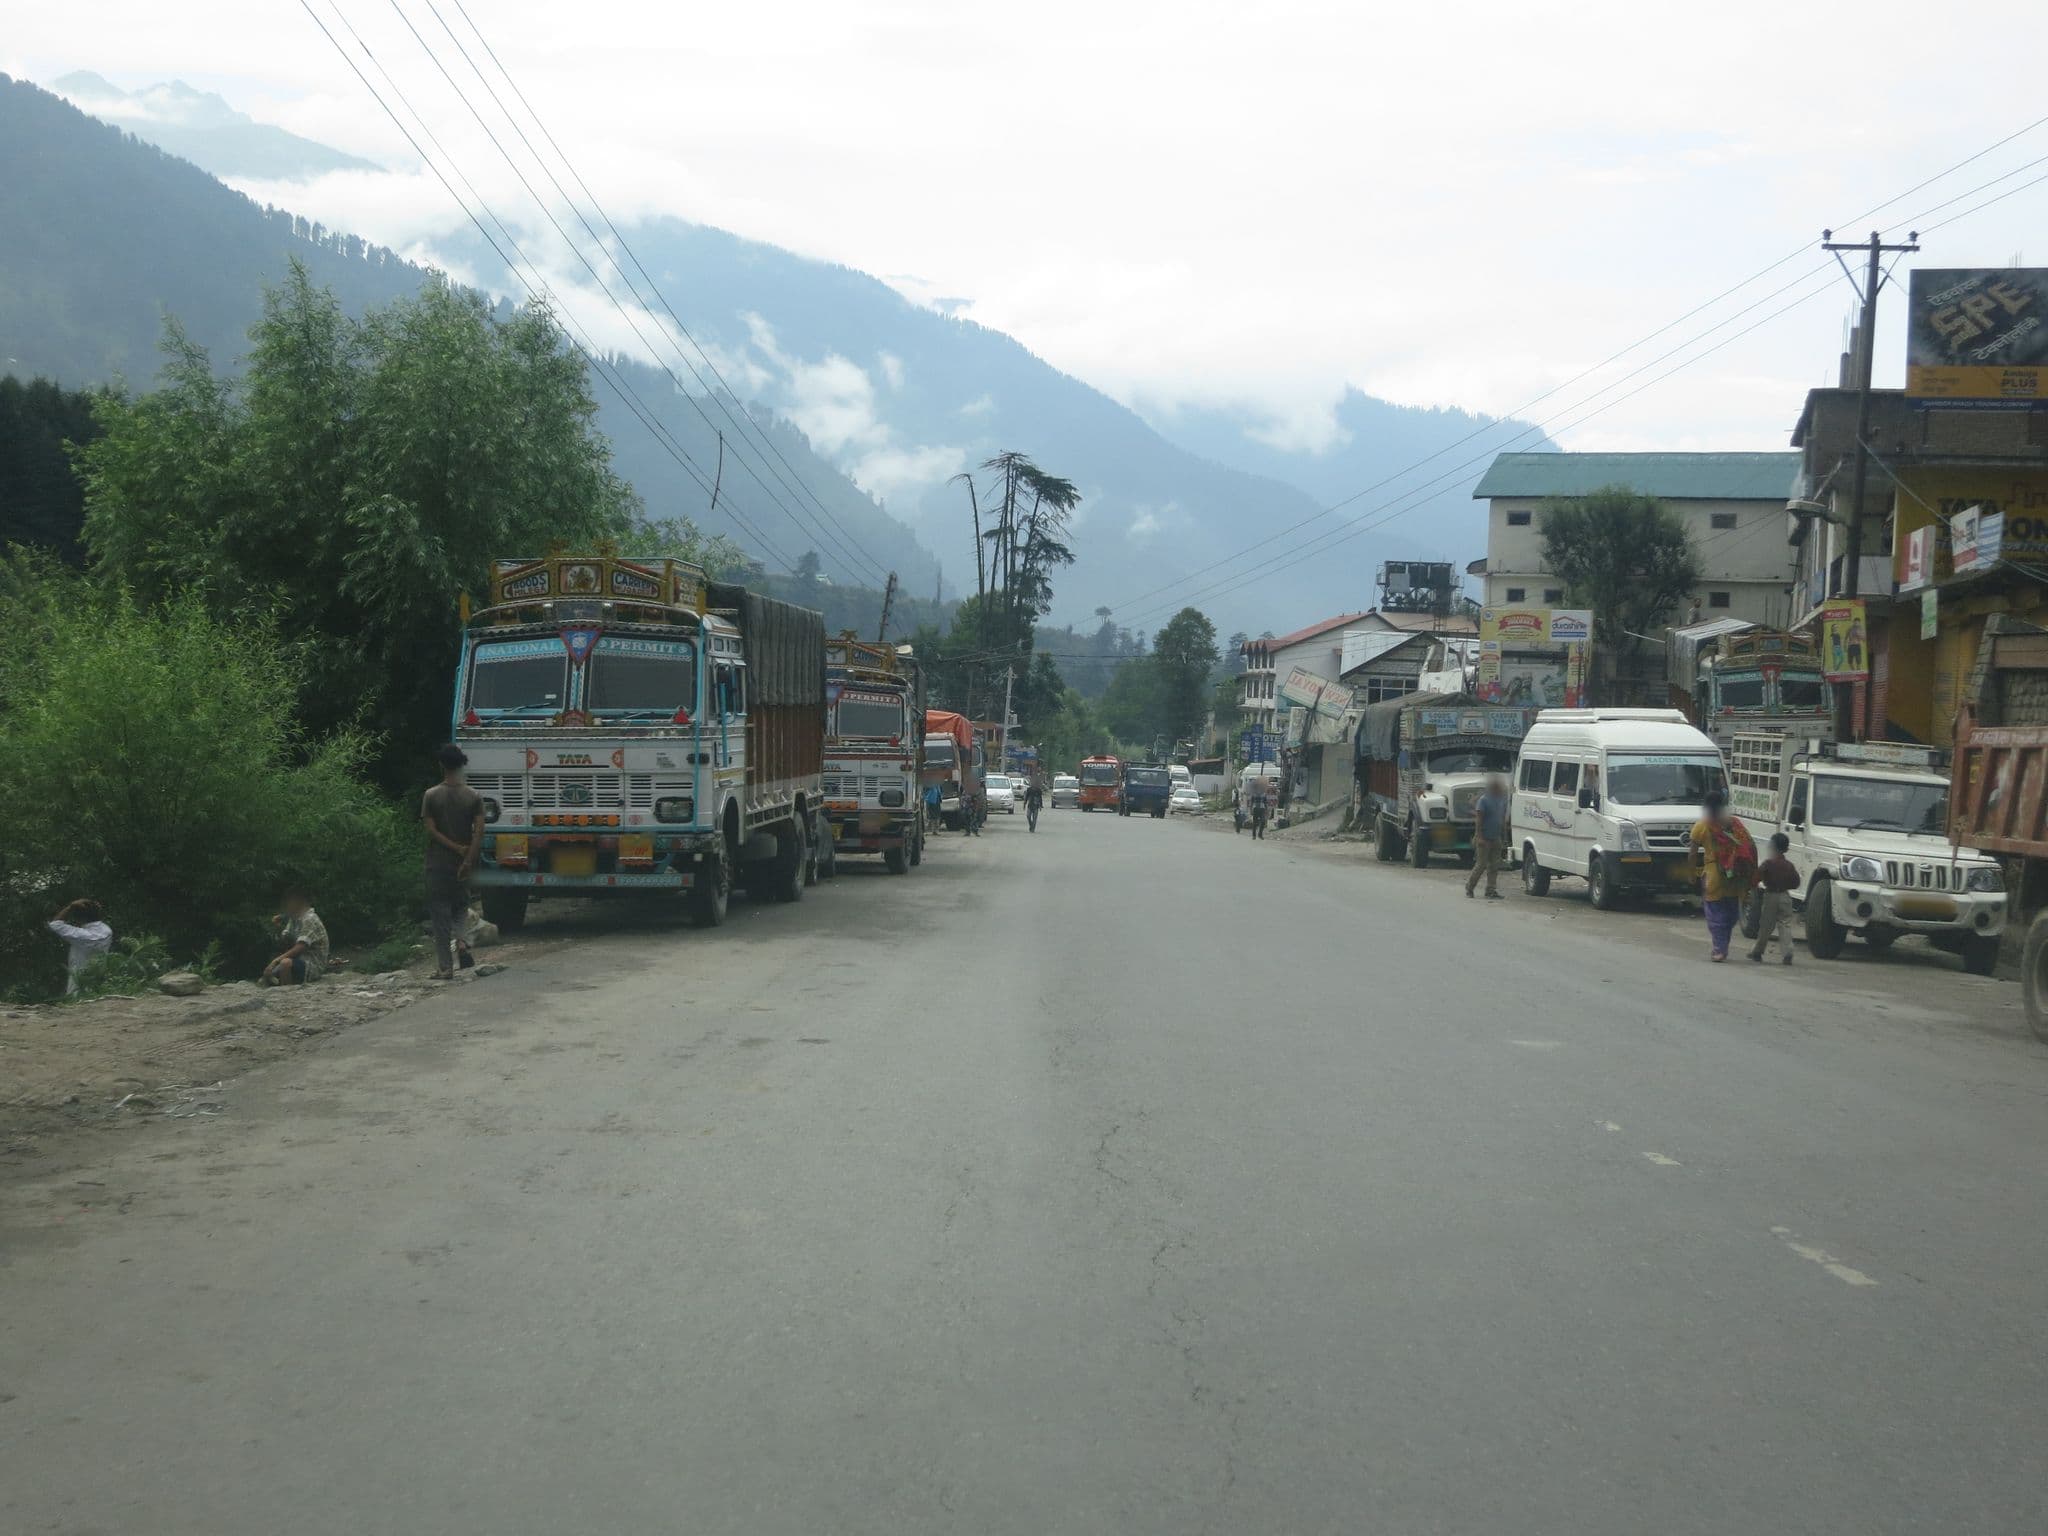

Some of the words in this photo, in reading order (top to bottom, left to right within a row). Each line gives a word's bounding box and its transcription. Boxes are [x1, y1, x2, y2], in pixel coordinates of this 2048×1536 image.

[1930, 281, 2033, 351] SPE
[2001, 378, 2038, 388] PLUS
[513, 573, 548, 589] GOODS
[486, 641, 556, 657] NATIONAL
[609, 641, 675, 654] PERMIT
[850, 693, 892, 703] PERMIT
[556, 753, 593, 765] TATA
